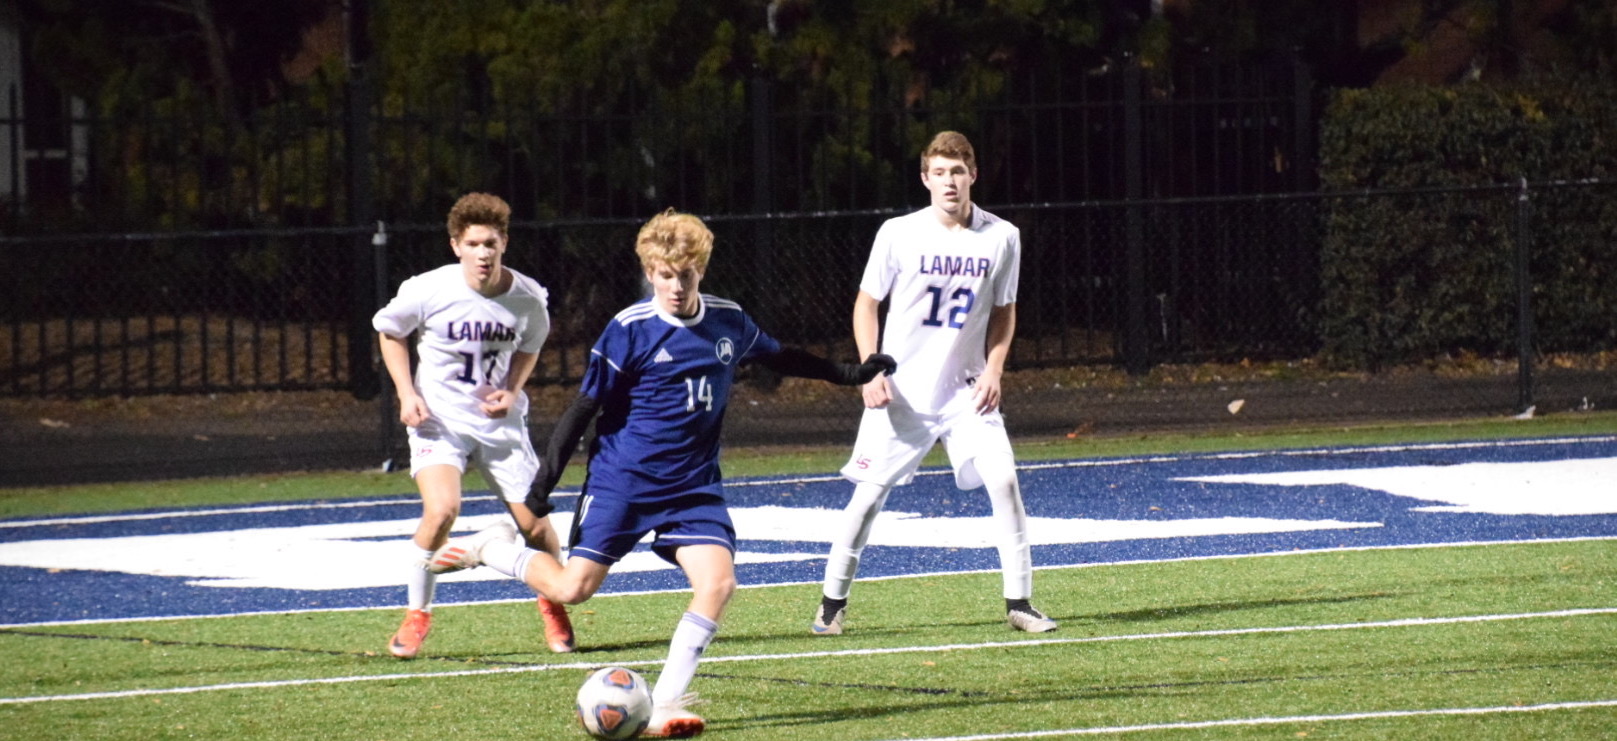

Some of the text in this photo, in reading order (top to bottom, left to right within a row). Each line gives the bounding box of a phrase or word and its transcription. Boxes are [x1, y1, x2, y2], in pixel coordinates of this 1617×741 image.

[919, 254, 989, 278] LAMAR
[922, 285, 974, 329] 12
[456, 349, 500, 386] 17
[684, 375, 713, 412] 14
